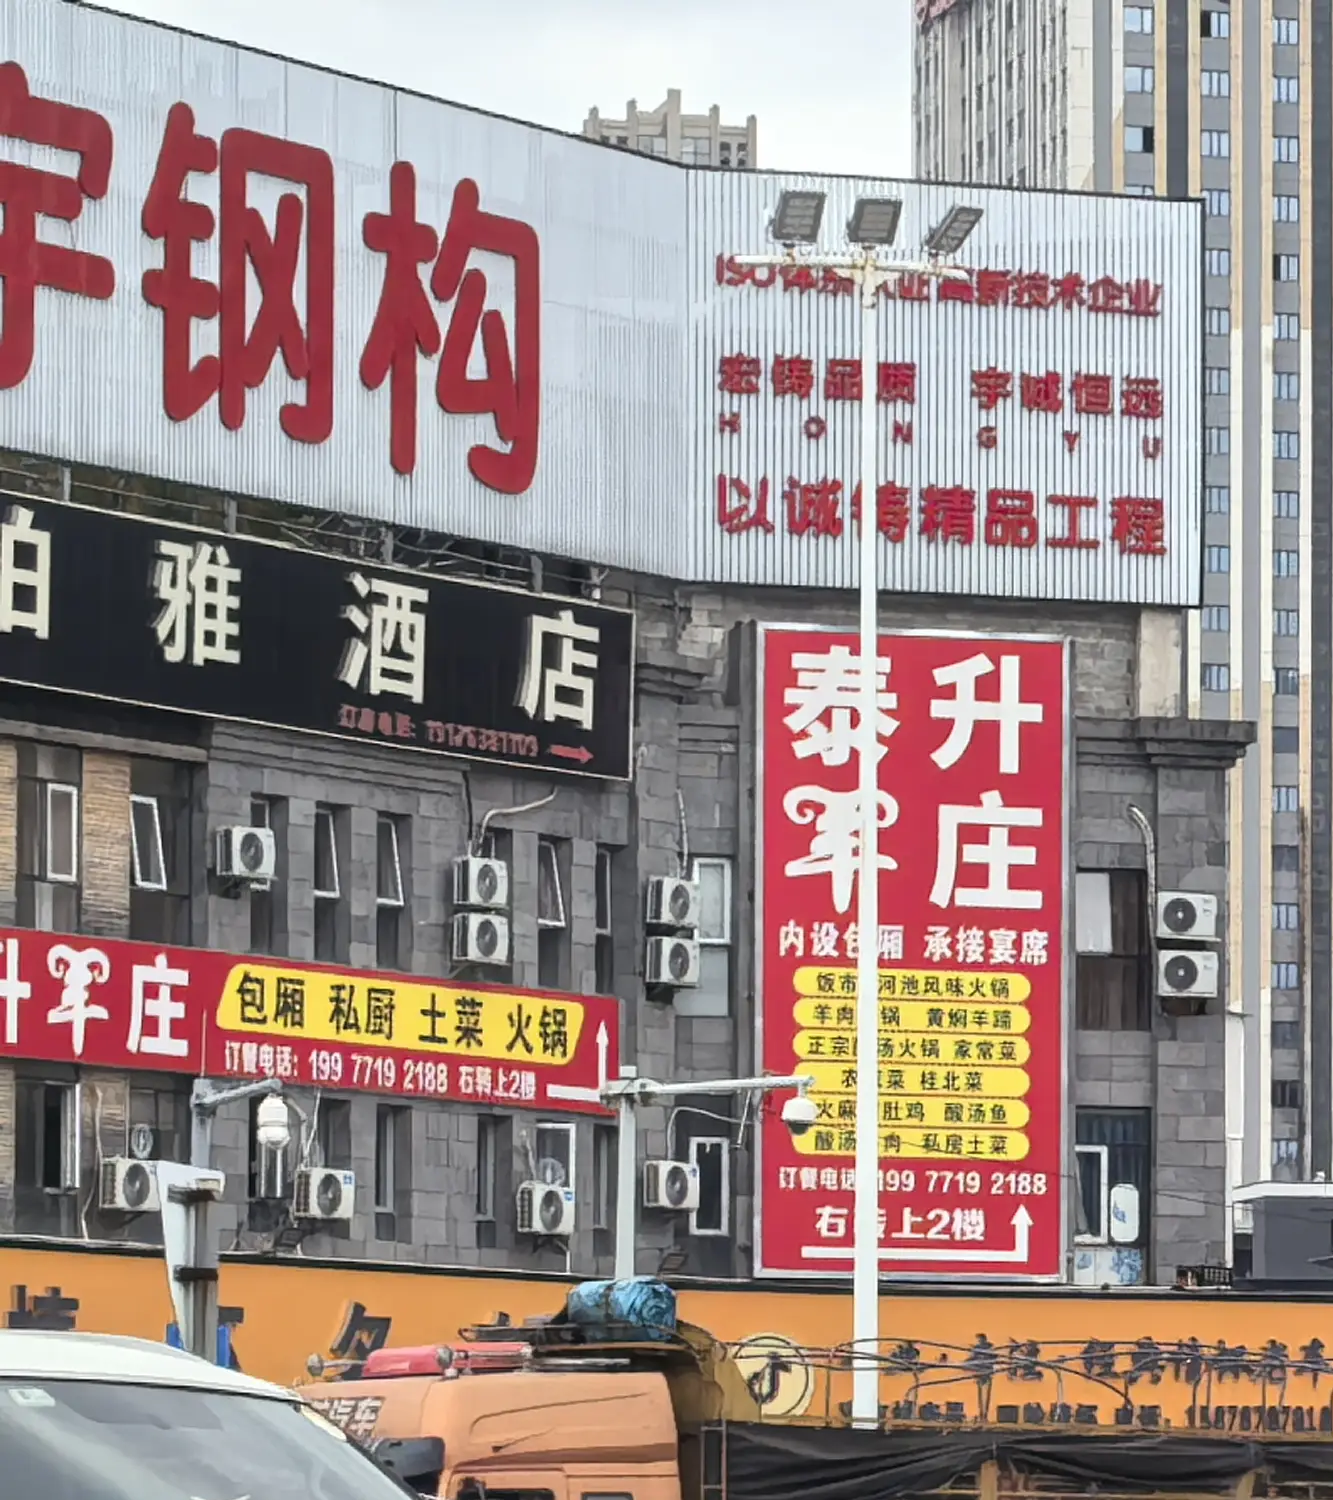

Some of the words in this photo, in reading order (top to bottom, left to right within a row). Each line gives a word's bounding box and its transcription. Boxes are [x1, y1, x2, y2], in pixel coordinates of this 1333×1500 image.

[782, 645, 1043, 775] 泰升
[923, 924, 1049, 966] 承接宴席
[236, 970, 307, 1029] 包厢
[329, 983, 396, 1043] 私厨
[418, 992, 485, 1050] 土菜
[505, 1001, 570, 1060] 火锅
[813, 1002, 902, 1027] 羊肉锅
[954, 1038, 1018, 1062] 家常菜
[308, 1049, 343, 1082] 199
[351, 1053, 396, 1087] 7719
[403, 1059, 448, 1094] 2188
[920, 1070, 983, 1092] 桂北菜
[877, 1169, 916, 1192] 199
[925, 1170, 981, 1195] 7719
[990, 1172, 1047, 1196] 2188
